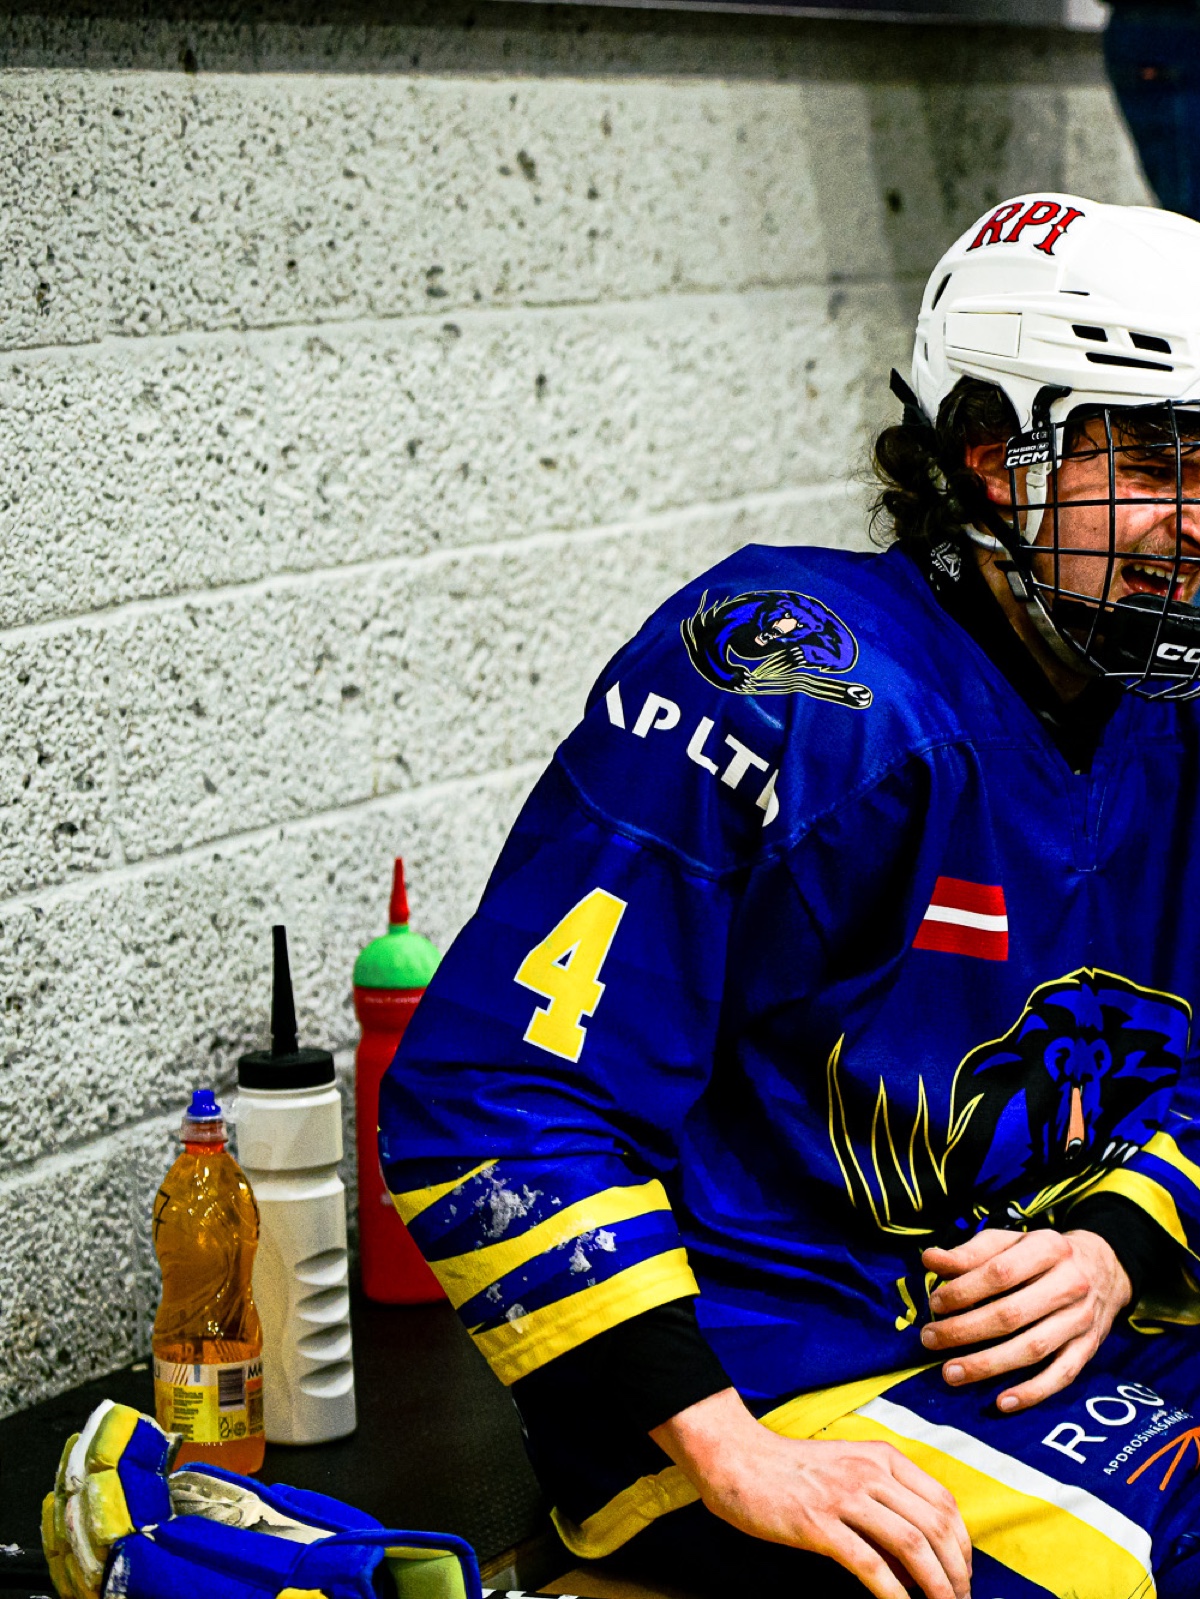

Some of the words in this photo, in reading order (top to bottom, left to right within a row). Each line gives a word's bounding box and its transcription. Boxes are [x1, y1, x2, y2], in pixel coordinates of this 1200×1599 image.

[966, 201, 1086, 256] RPI
[1006, 450, 1050, 467] CCM
[513, 887, 628, 1064] 4
